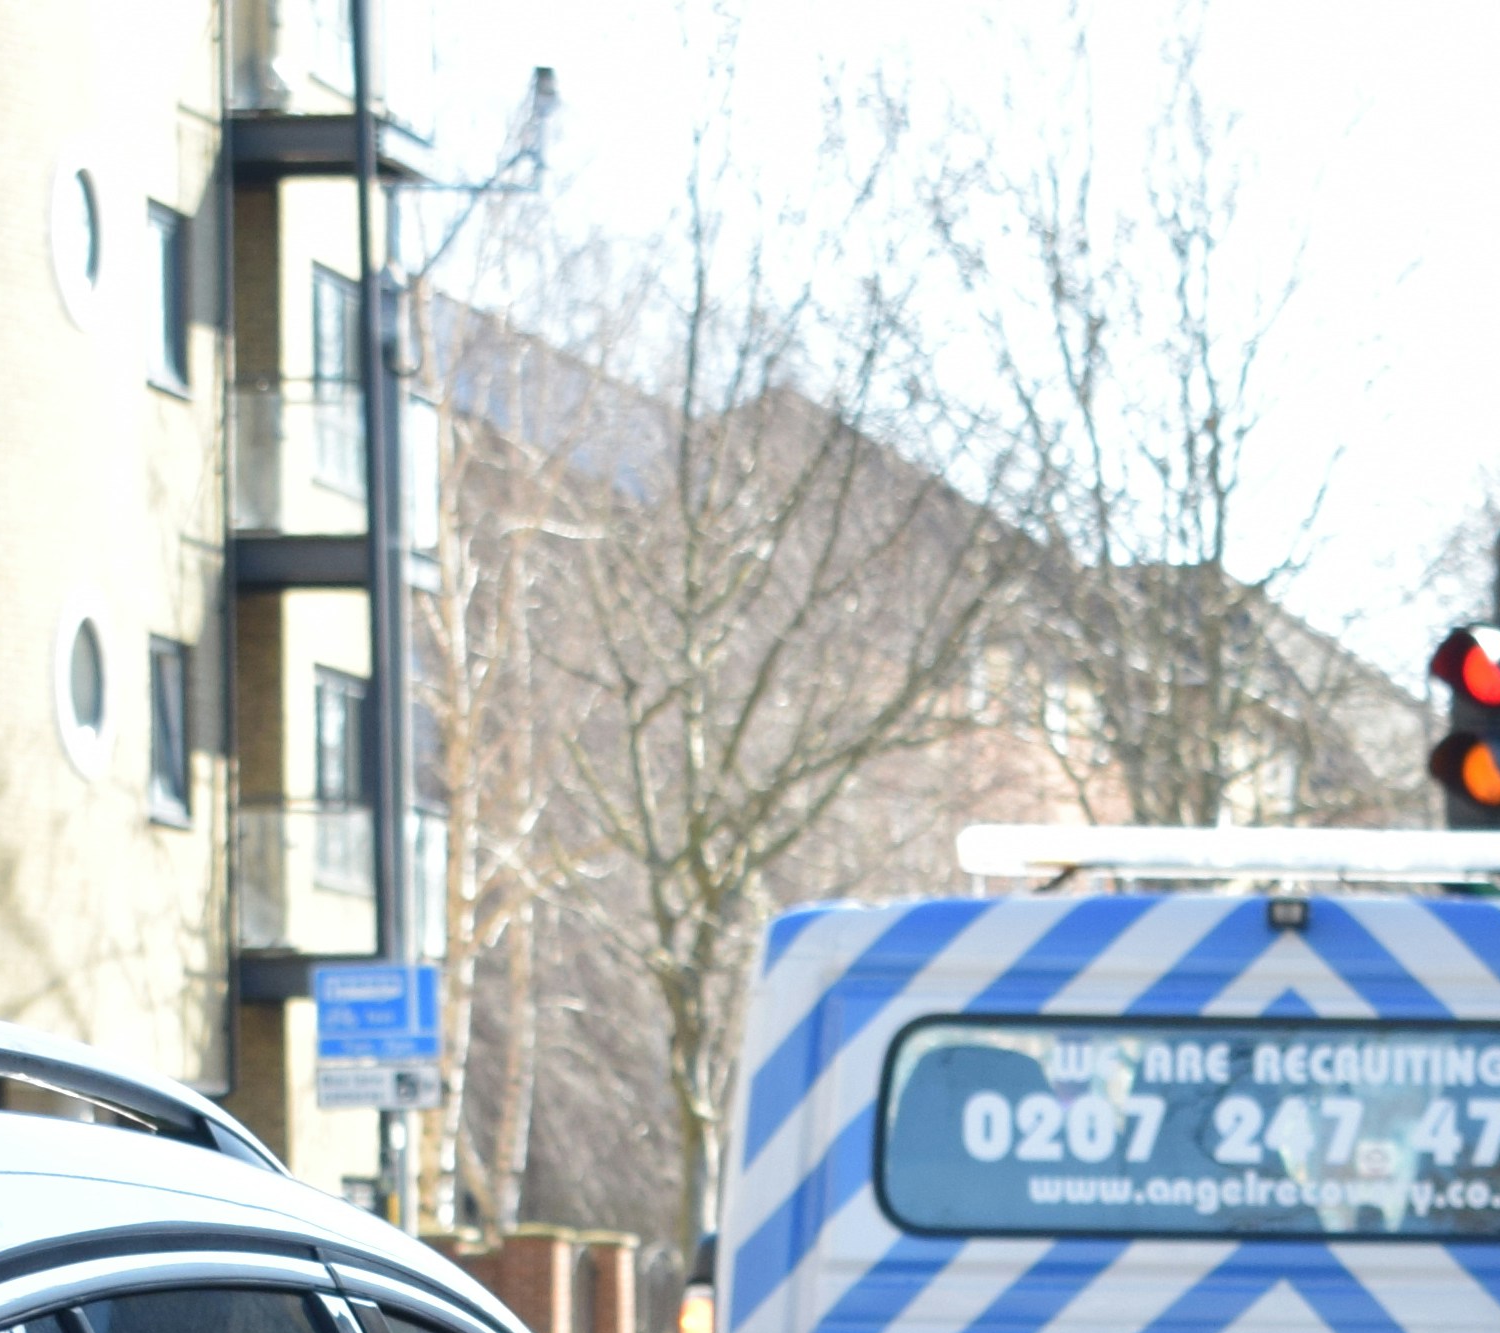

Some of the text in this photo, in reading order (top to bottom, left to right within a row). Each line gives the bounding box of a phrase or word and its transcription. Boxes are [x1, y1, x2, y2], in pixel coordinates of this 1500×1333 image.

[1143, 1042, 1232, 1084] ARE
[961, 1090, 1166, 1164] 0207
[1212, 1095, 1364, 1166] 247
